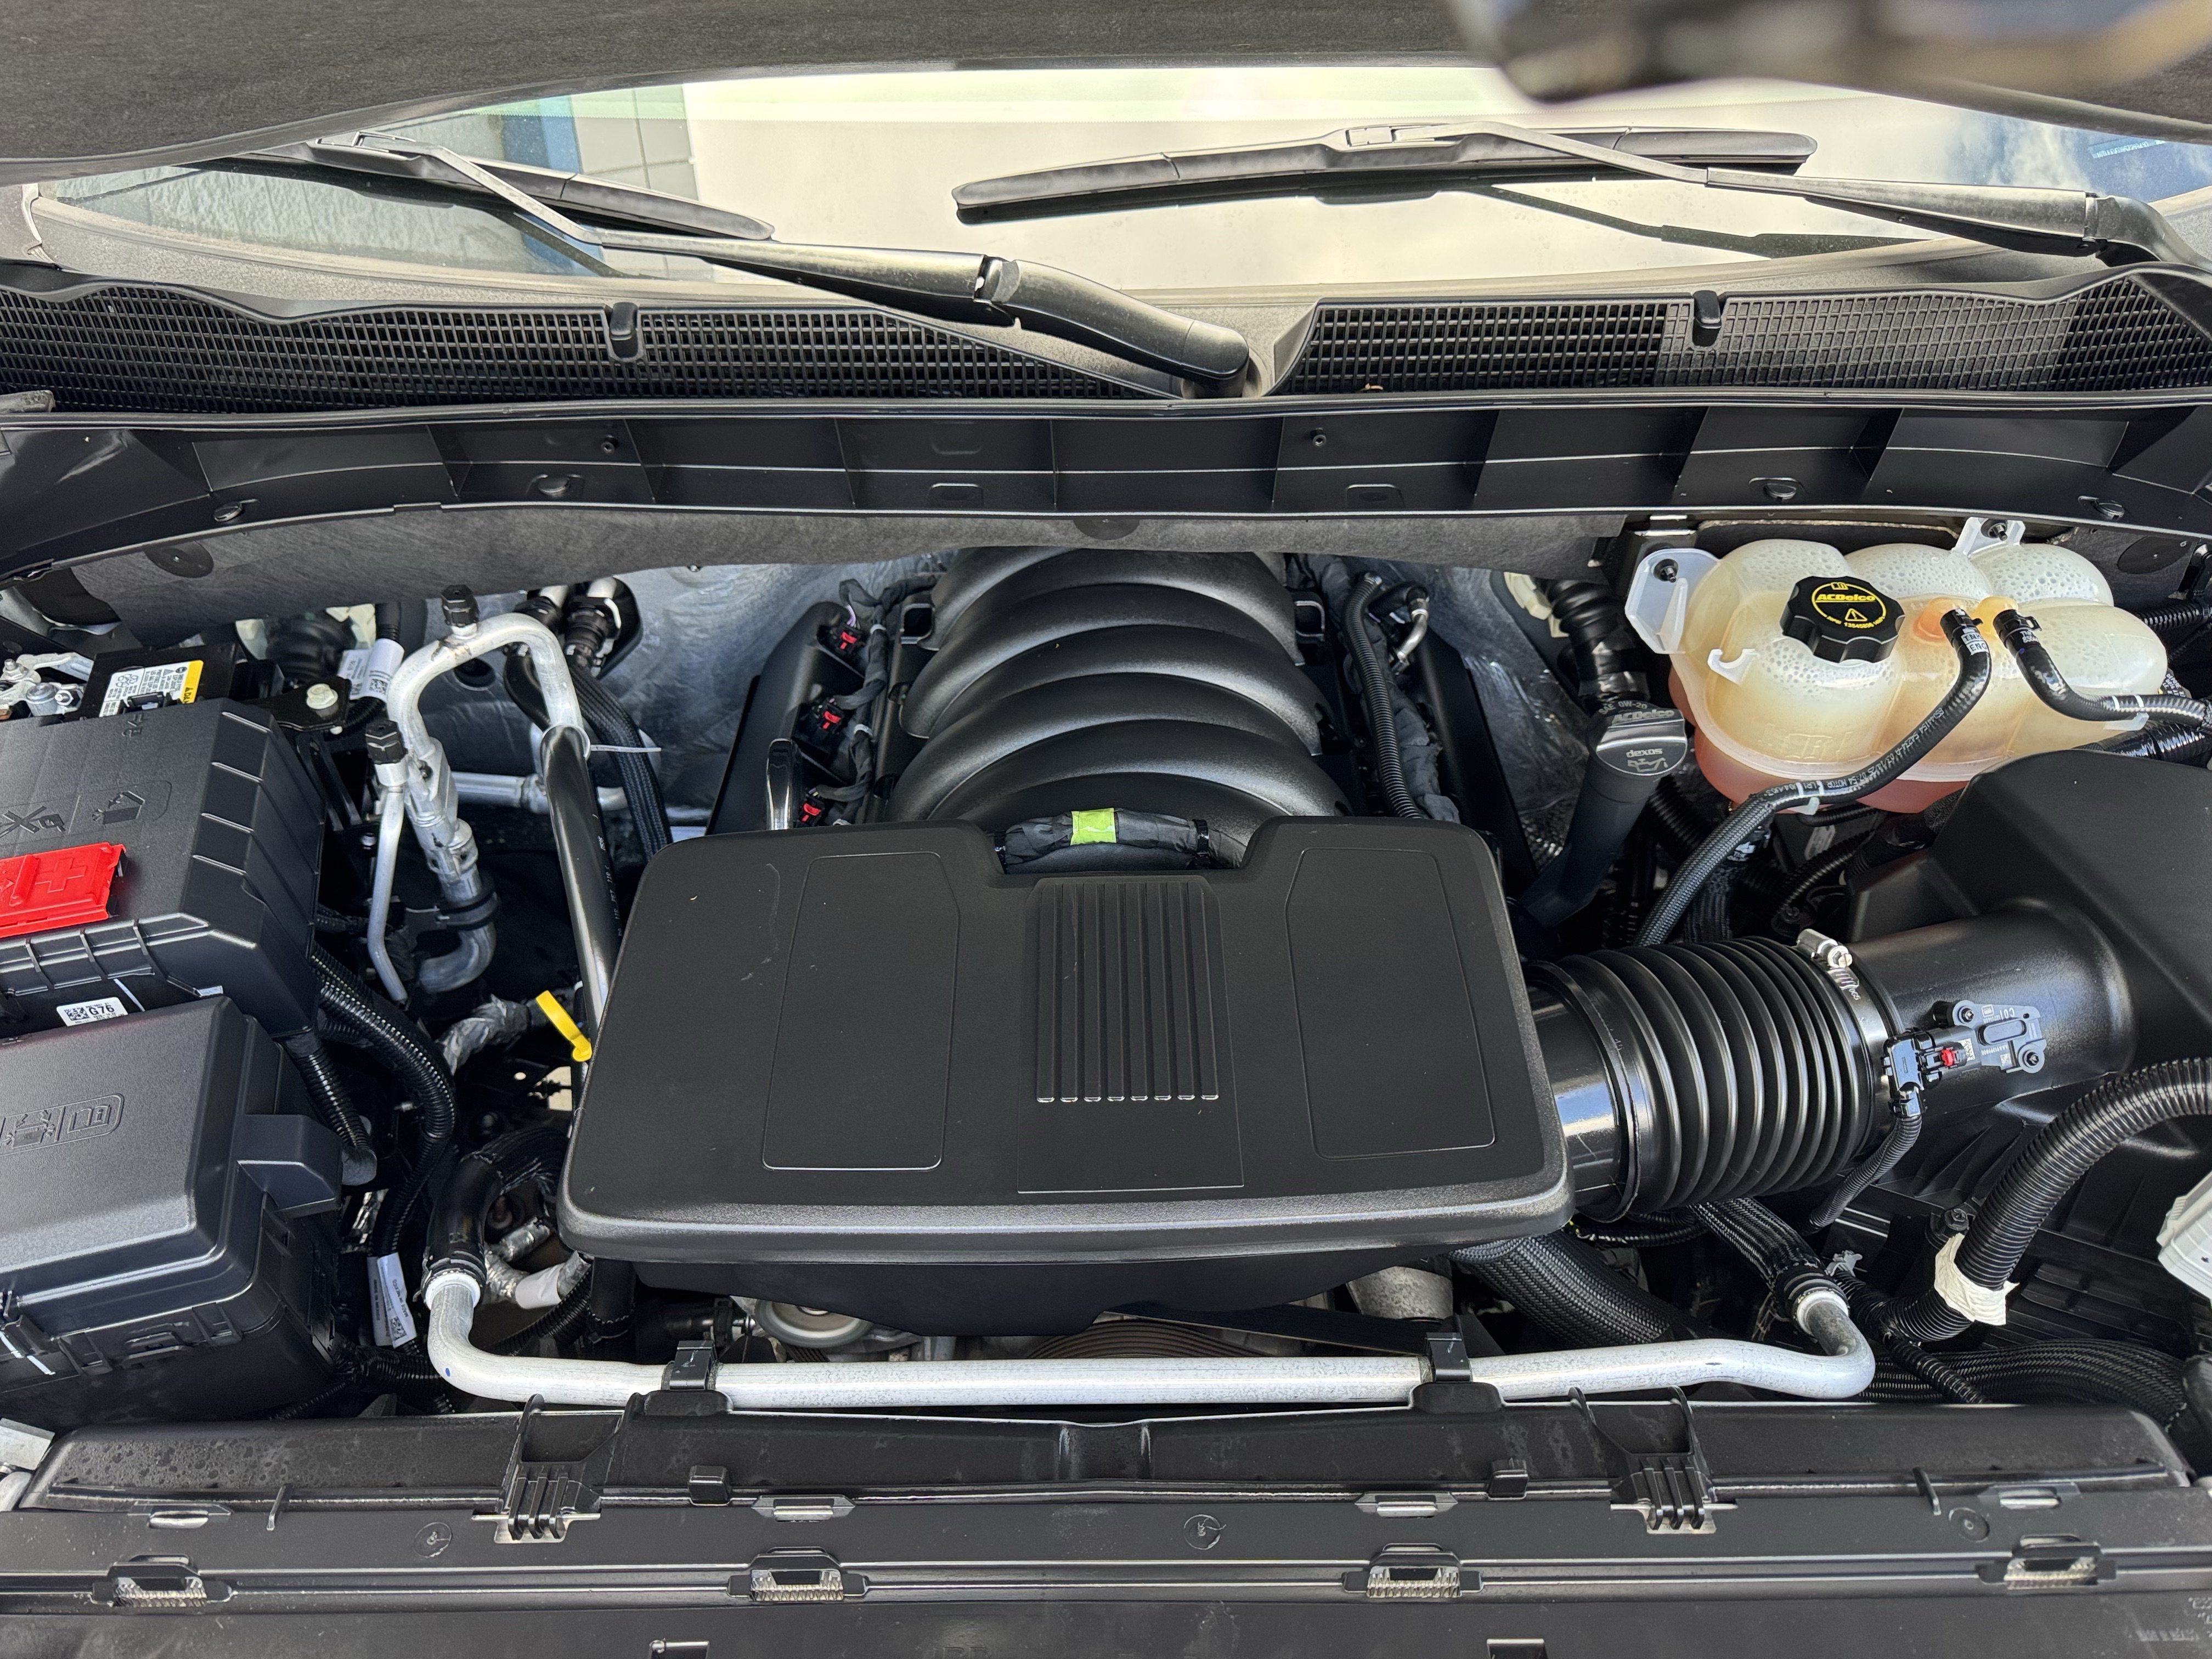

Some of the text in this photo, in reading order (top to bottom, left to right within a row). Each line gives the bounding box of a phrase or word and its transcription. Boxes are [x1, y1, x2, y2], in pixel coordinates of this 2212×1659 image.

[1969, 642, 1988, 652] ENG
[1599, 701, 1647, 714] SAE 0W-20
[1612, 709, 1675, 724] ACDelco
[1626, 748, 1663, 758] dexos
[88, 1005, 114, 1015] G76
